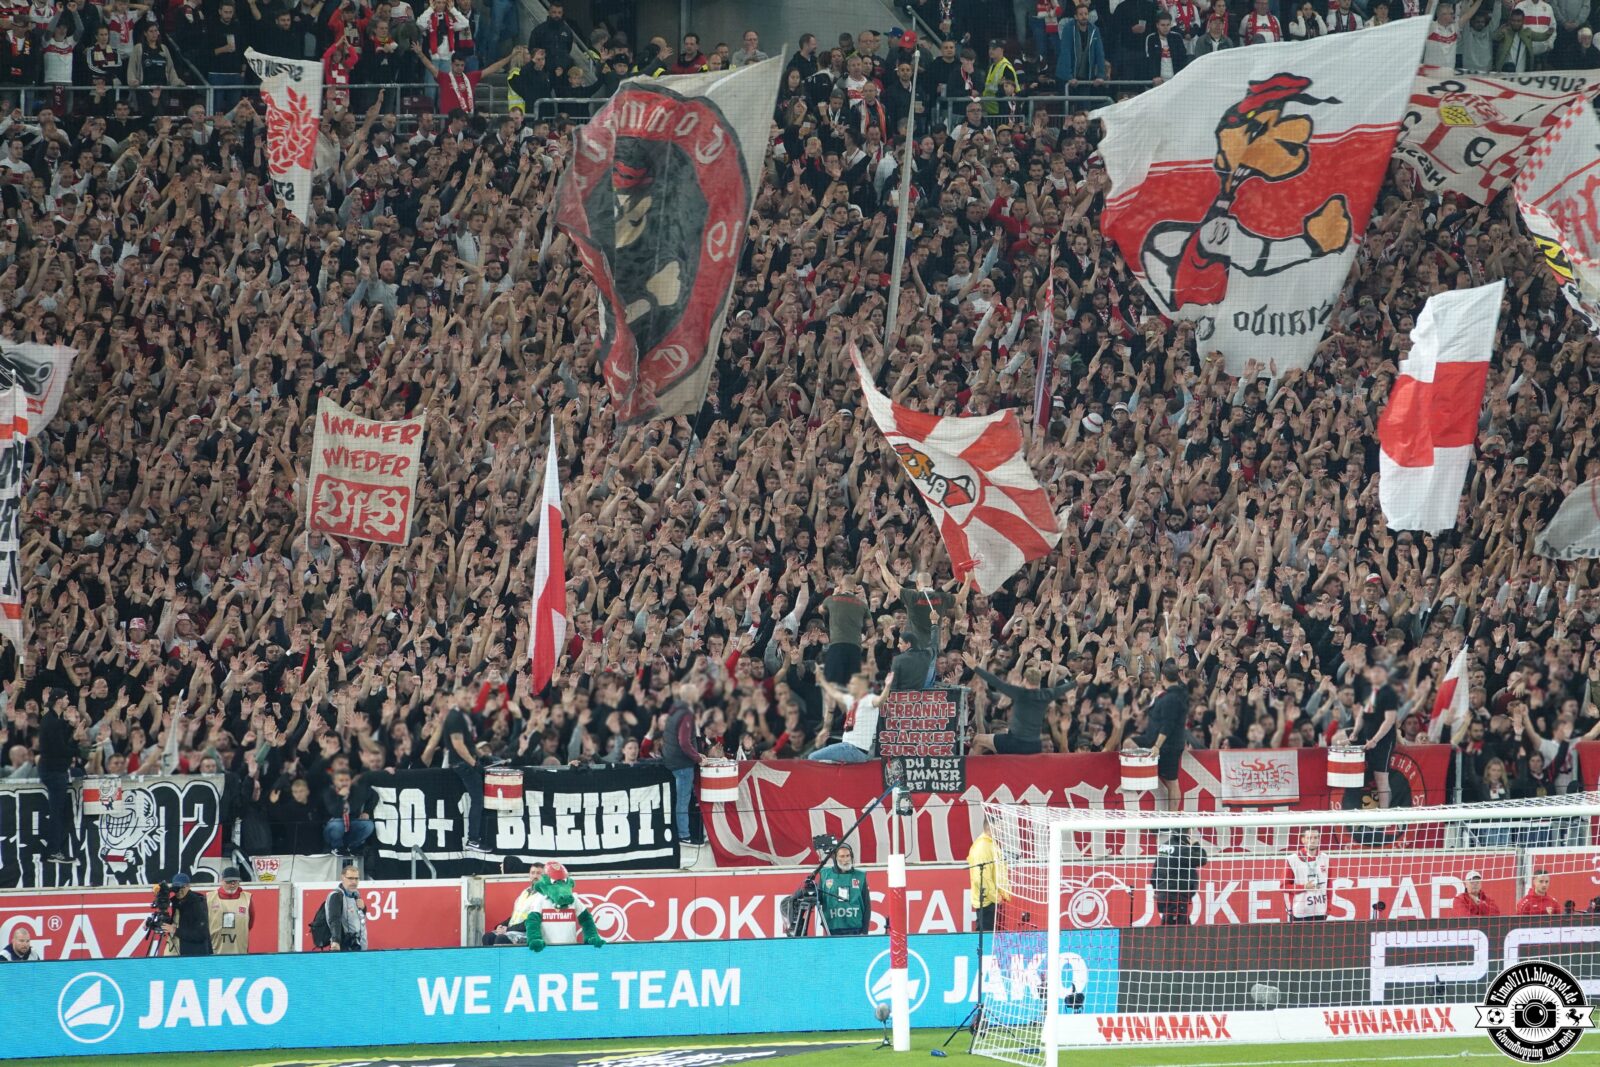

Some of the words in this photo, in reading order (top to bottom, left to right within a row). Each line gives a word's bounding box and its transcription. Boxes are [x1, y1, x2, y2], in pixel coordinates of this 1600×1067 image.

[321, 411, 422, 445] IMMER
[322, 445, 411, 478] WIEDER
[887, 691, 948, 703] JEDER
[880, 702, 957, 718] VERBANNTE
[886, 718, 949, 731] KEHRT
[880, 743, 955, 757] ZURÜCK
[905, 758, 925, 769] DU
[930, 758, 961, 769] BIST
[906, 769, 961, 781] IMMER
[931, 781, 963, 791] UNS!
[496, 782, 673, 851] BLEIBT!
[366, 891, 399, 921] 34
[829, 907, 860, 919] HOST
[542, 912, 574, 920] STUTTGART
[221, 933, 238, 944] TV
[943, 952, 1089, 1004] JAKO
[417, 975, 492, 1016] WE
[503, 972, 599, 1013] ARE
[611, 968, 741, 1010] TEAM
[138, 976, 289, 1030] JAKO
[1097, 1013, 1232, 1042] WINAMAX
[1324, 1006, 1457, 1035] WINAMAX
